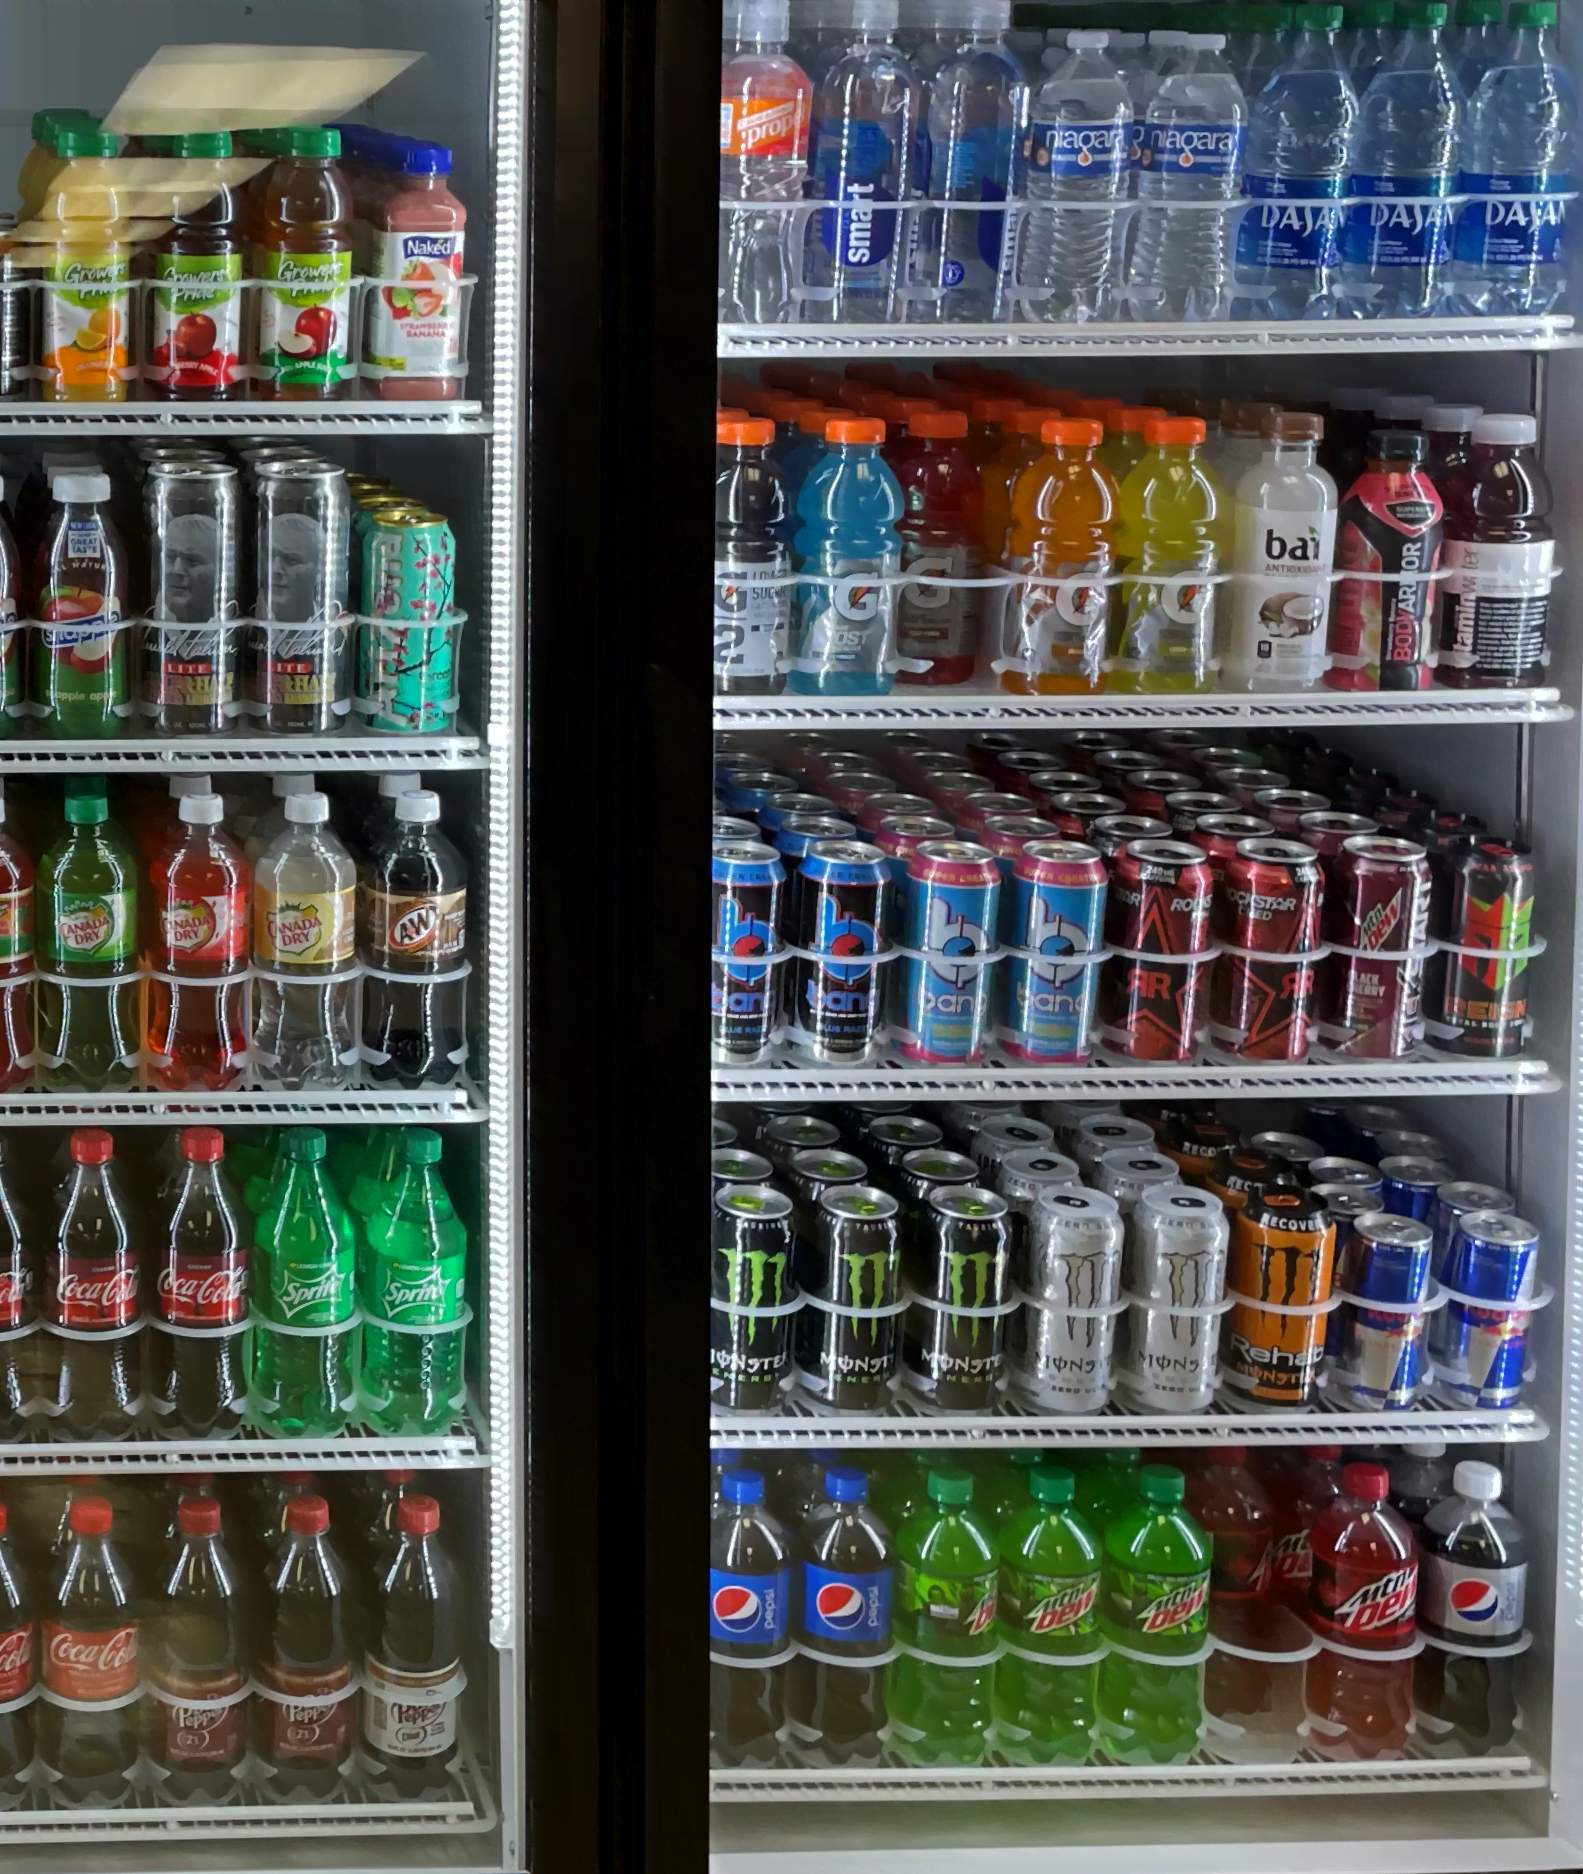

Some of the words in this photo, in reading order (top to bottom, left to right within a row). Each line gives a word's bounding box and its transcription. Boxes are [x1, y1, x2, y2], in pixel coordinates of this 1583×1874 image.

[1046, 129, 1124, 152] niagara
[1150, 129, 1232, 152] niagara
[847, 182, 874, 264] smart
[406, 238, 451, 255] Naked
[65, 261, 125, 283] Growers
[164, 266, 227, 283] Growers
[278, 260, 343, 281] Growers
[70, 538, 98, 546] GREAT
[71, 545, 98, 554] TASTE
[1265, 527, 1321, 562] bai
[167, 664, 208, 673] LITE
[59, 916, 110, 935] CANADA
[161, 914, 210, 934] CANADA
[174, 926, 201, 942] DRY
[267, 917, 323, 940] CANADA
[74, 930, 100, 947] DRY
[281, 931, 310, 947] DRY
[57, 1269, 139, 1306] Coca-Cola
[156, 1266, 247, 1306] Coca-Cola
[286, 1281, 341, 1310] Sprite
[384, 1280, 445, 1312] Sprite
[1230, 1334, 1323, 1367] Rehab
[764, 1587, 775, 1630] pepsi
[867, 1585, 879, 1628] pepsi
[50, 1627, 138, 1671] Coca-Cola
[185, 1734, 199, 1745] 23
[296, 1730, 310, 1740] 23
